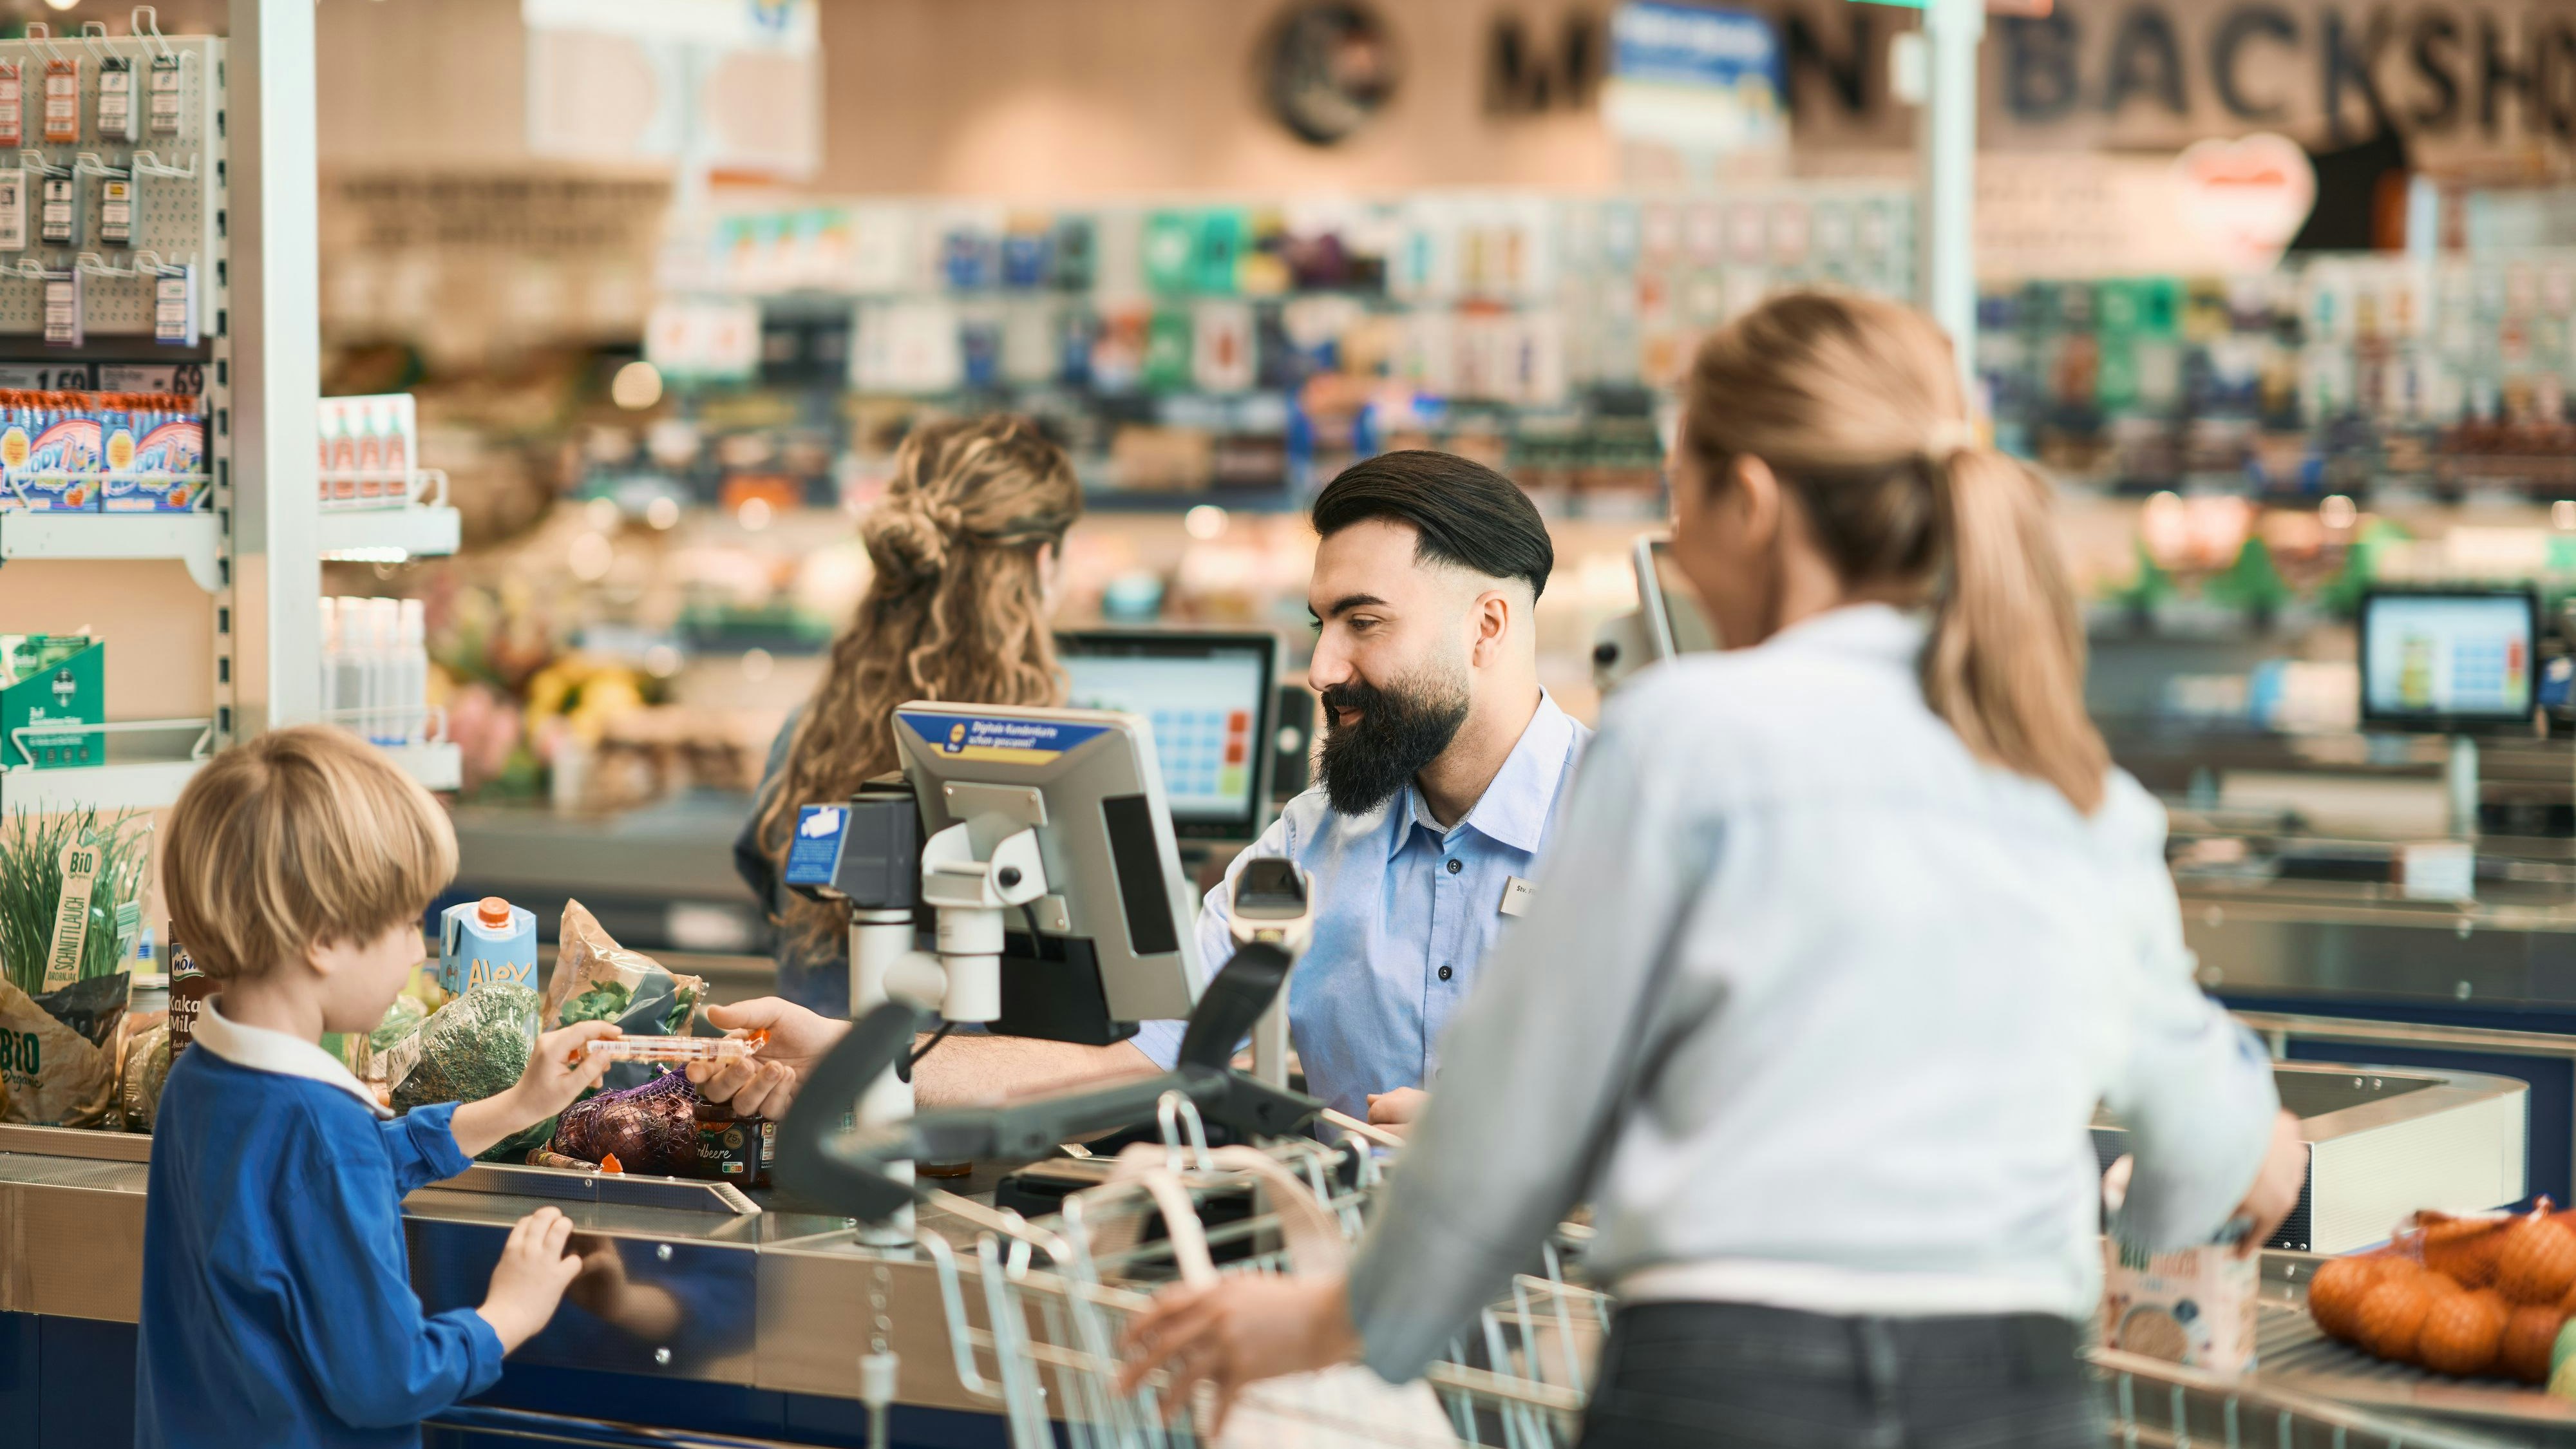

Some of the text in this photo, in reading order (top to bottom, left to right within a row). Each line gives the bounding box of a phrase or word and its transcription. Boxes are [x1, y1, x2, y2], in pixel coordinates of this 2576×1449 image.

[1481, 10, 1873, 121] MN
[1517, 885, 1527, 893] Stv.
[54, 896, 84, 971] SCHNITTLAUCH
[169, 994, 201, 1013] Kaka
